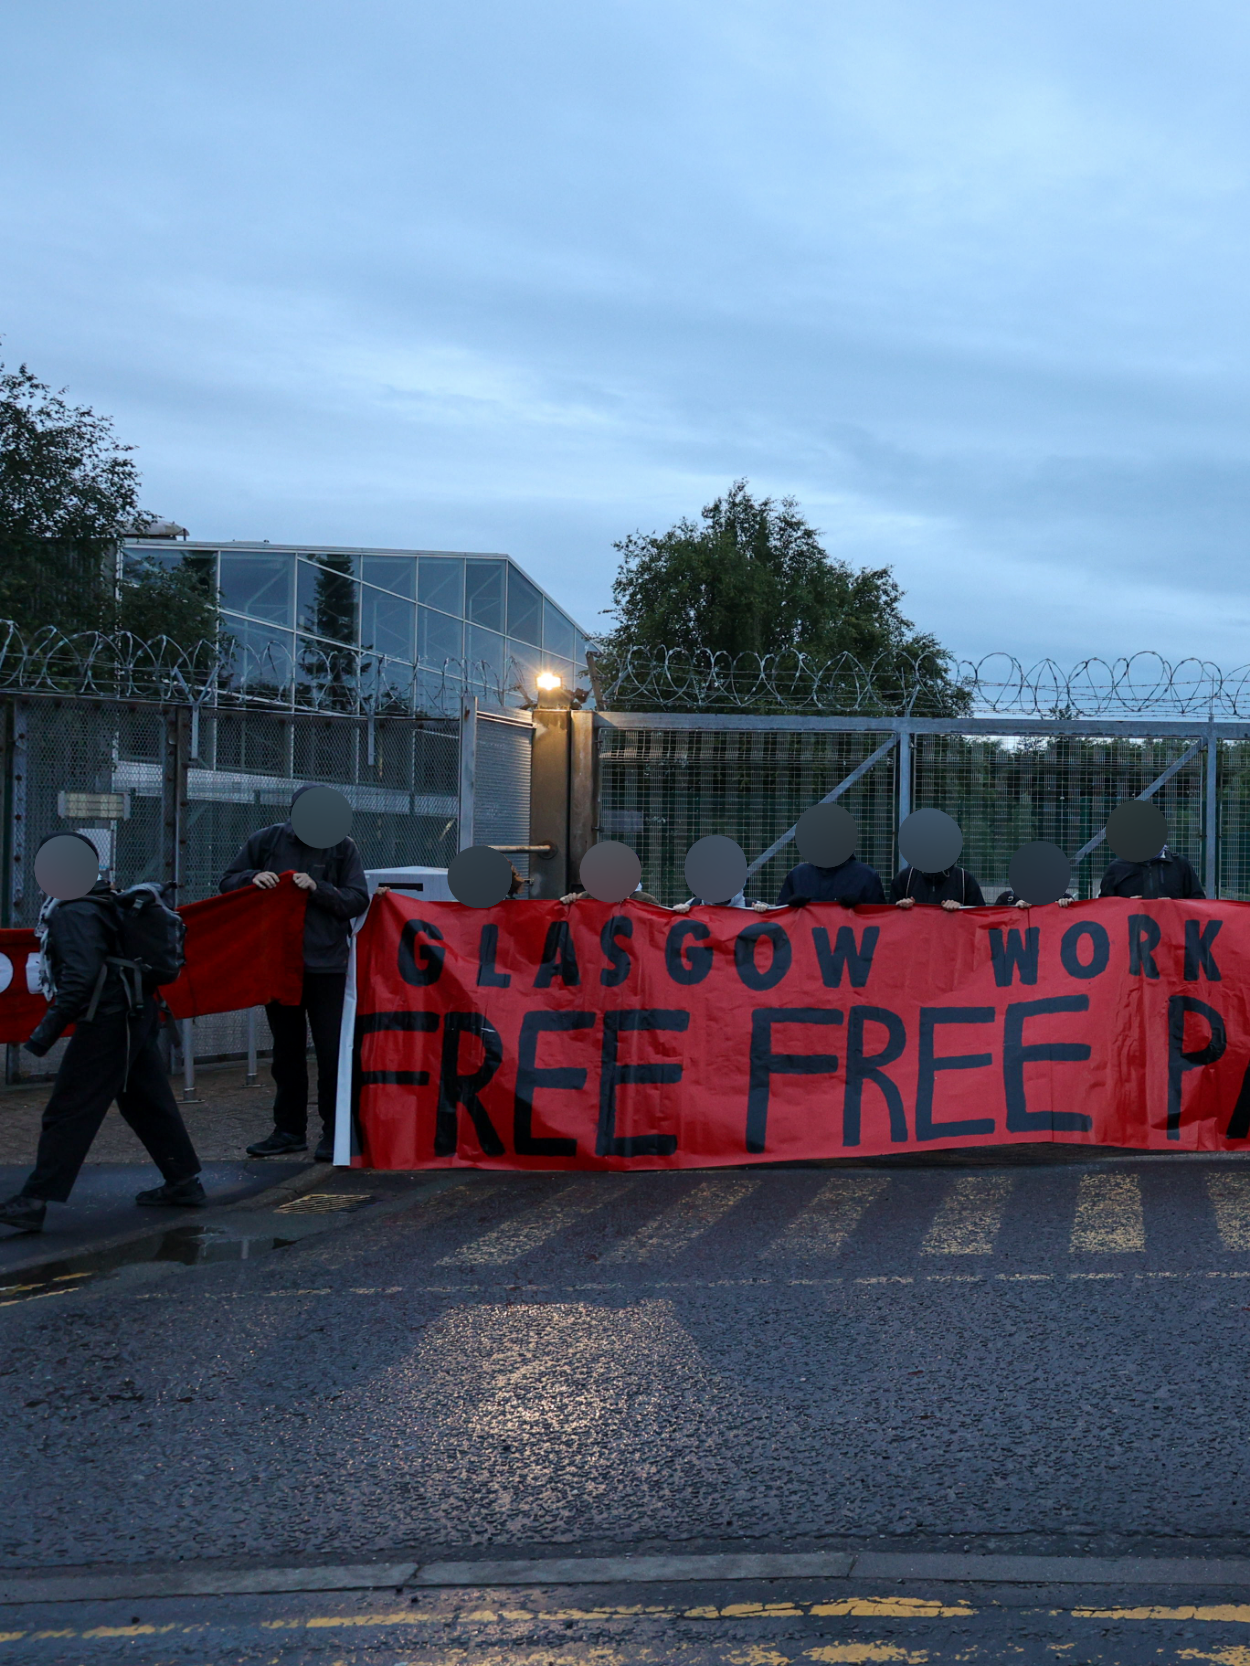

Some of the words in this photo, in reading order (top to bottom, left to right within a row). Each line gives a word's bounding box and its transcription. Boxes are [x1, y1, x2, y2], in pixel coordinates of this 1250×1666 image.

[397, 915, 880, 991] GLASGOW
[349, 1008, 690, 1157] FREE
[745, 994, 1093, 1154] FREE
